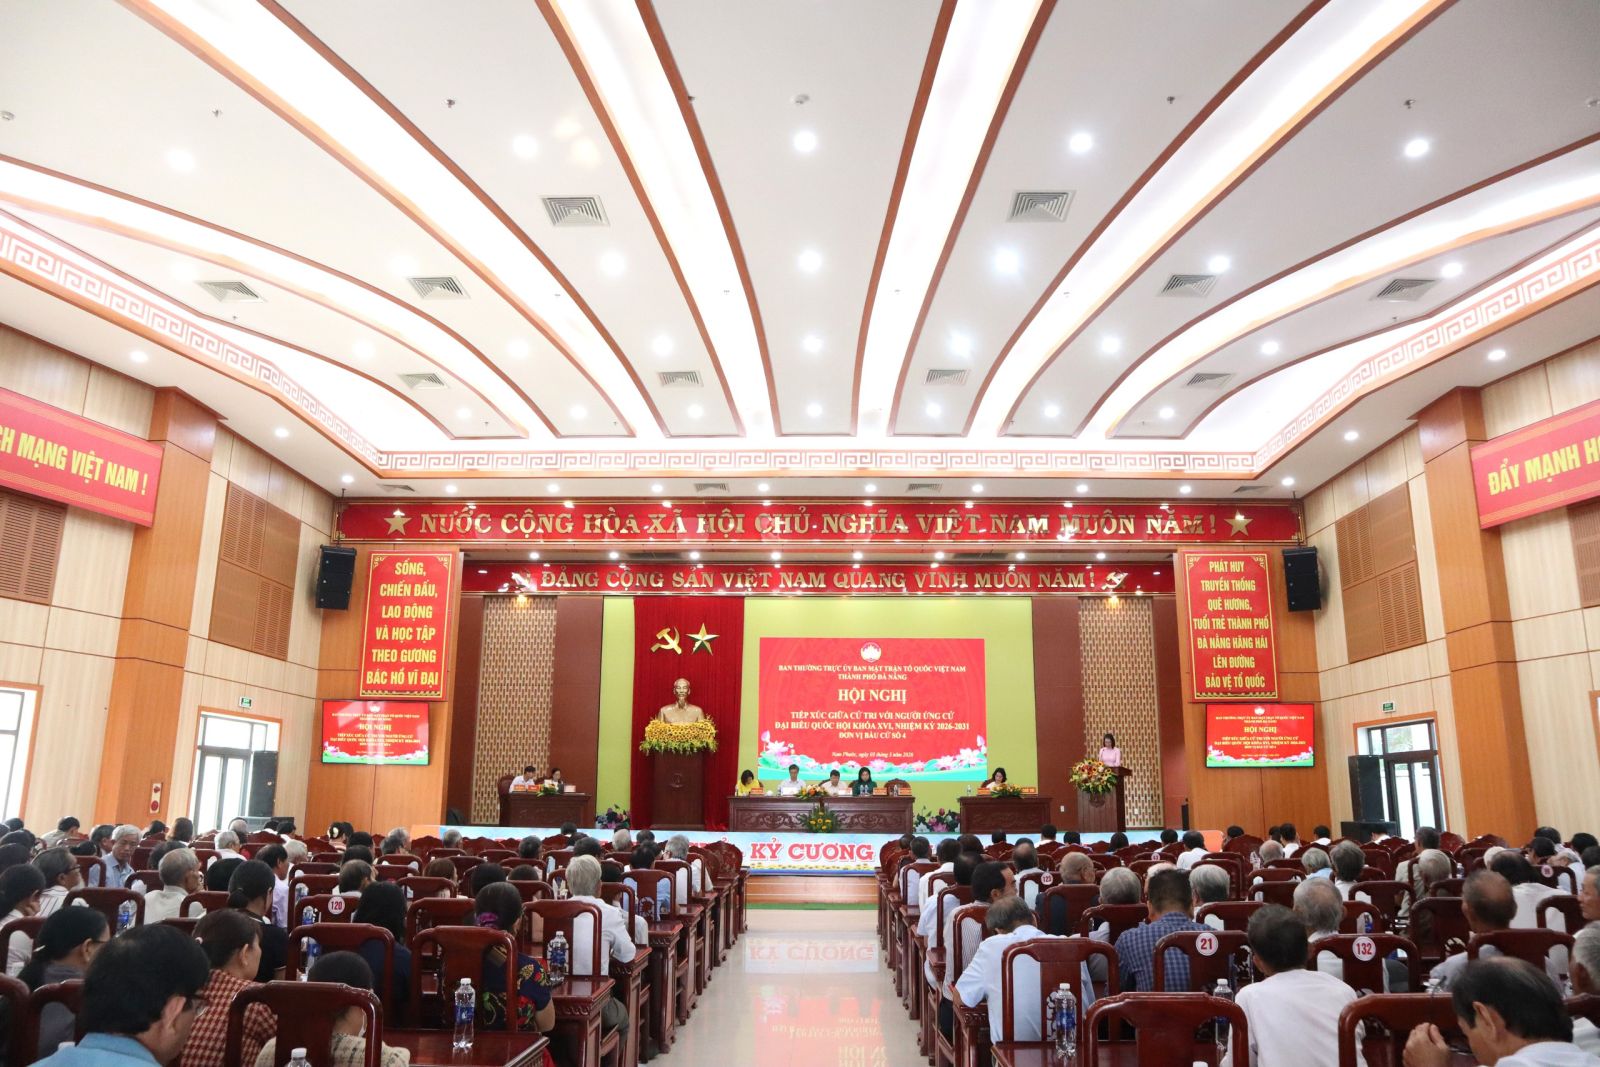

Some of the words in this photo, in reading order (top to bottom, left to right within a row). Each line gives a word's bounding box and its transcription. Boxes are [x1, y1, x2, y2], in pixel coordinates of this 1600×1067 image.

[17, 432, 68, 470] MẠNG
[70, 450, 104, 484] VIỆT
[104, 461, 140, 492] NAM
[1488, 458, 1520, 496] ĐẨY
[1524, 444, 1581, 483] MẠNH
[1584, 436, 1600, 464] H
[420, 506, 492, 533] NƯỚC
[501, 508, 574, 538] CỘNG
[583, 506, 640, 534] HÒA
[647, 508, 688, 534] XÃ
[696, 508, 745, 538] HỘI
[754, 506, 810, 534] CHỦ
[822, 509, 909, 534] NGHĨA
[916, 509, 982, 538] VIỆT
[990, 514, 1050, 534] NAM
[1058, 509, 1136, 534] MUÔN
[394, 558, 426, 576] SỐNG,
[1209, 560, 1228, 572] PHÁT
[1230, 561, 1244, 572] HUY
[540, 566, 600, 588] ĐẢNG
[606, 567, 664, 590] CỘNG
[672, 566, 715, 588] SẢN
[721, 568, 772, 592] VIỆT
[779, 572, 826, 588] NAM
[834, 572, 906, 588] QUANG
[914, 572, 968, 588] VINH
[974, 567, 1031, 588] MUÔN
[1200, 578, 1230, 592] TRUYỀN
[1232, 578, 1256, 592] THỐNG
[380, 582, 412, 597] CHIẾN
[414, 579, 438, 598] ĐẤU,
[1208, 598, 1222, 611] QUÊ
[382, 606, 401, 618] LAO
[403, 604, 432, 622] ĐỘNG
[1194, 614, 1210, 630] TUỔI
[1212, 614, 1226, 630] TRẺ
[1228, 616, 1252, 630] THÀNH
[1254, 615, 1269, 630] PHỐ
[376, 625, 389, 640] VÀ
[392, 628, 414, 643] HỌC
[416, 626, 436, 643] TẬP
[1198, 635, 1208, 649] ĐÀ
[1255, 635, 1268, 649] HÁI
[372, 649, 398, 662] THEO
[400, 649, 436, 663] GƯƠNG
[1213, 655, 1228, 668] LÊN
[366, 669, 388, 684] BÁC
[390, 668, 404, 684] HỒ
[408, 670, 419, 684] VĨ
[420, 672, 438, 688] ĐẠI
[1205, 674, 1221, 688] BẢO
[1223, 674, 1232, 690] VỆ
[1234, 674, 1244, 688] TỔ
[1245, 674, 1266, 688] QUỐC
[838, 687, 865, 704] HỘI
[869, 689, 906, 704] NGHỊ
[836, 721, 850, 730] HỘI
[750, 838, 782, 859] KỶ
[788, 842, 874, 860] CƯƠNG
[331, 902, 342, 910] 120
[1200, 938, 1212, 950] 21
[1356, 943, 1372, 955] 132
